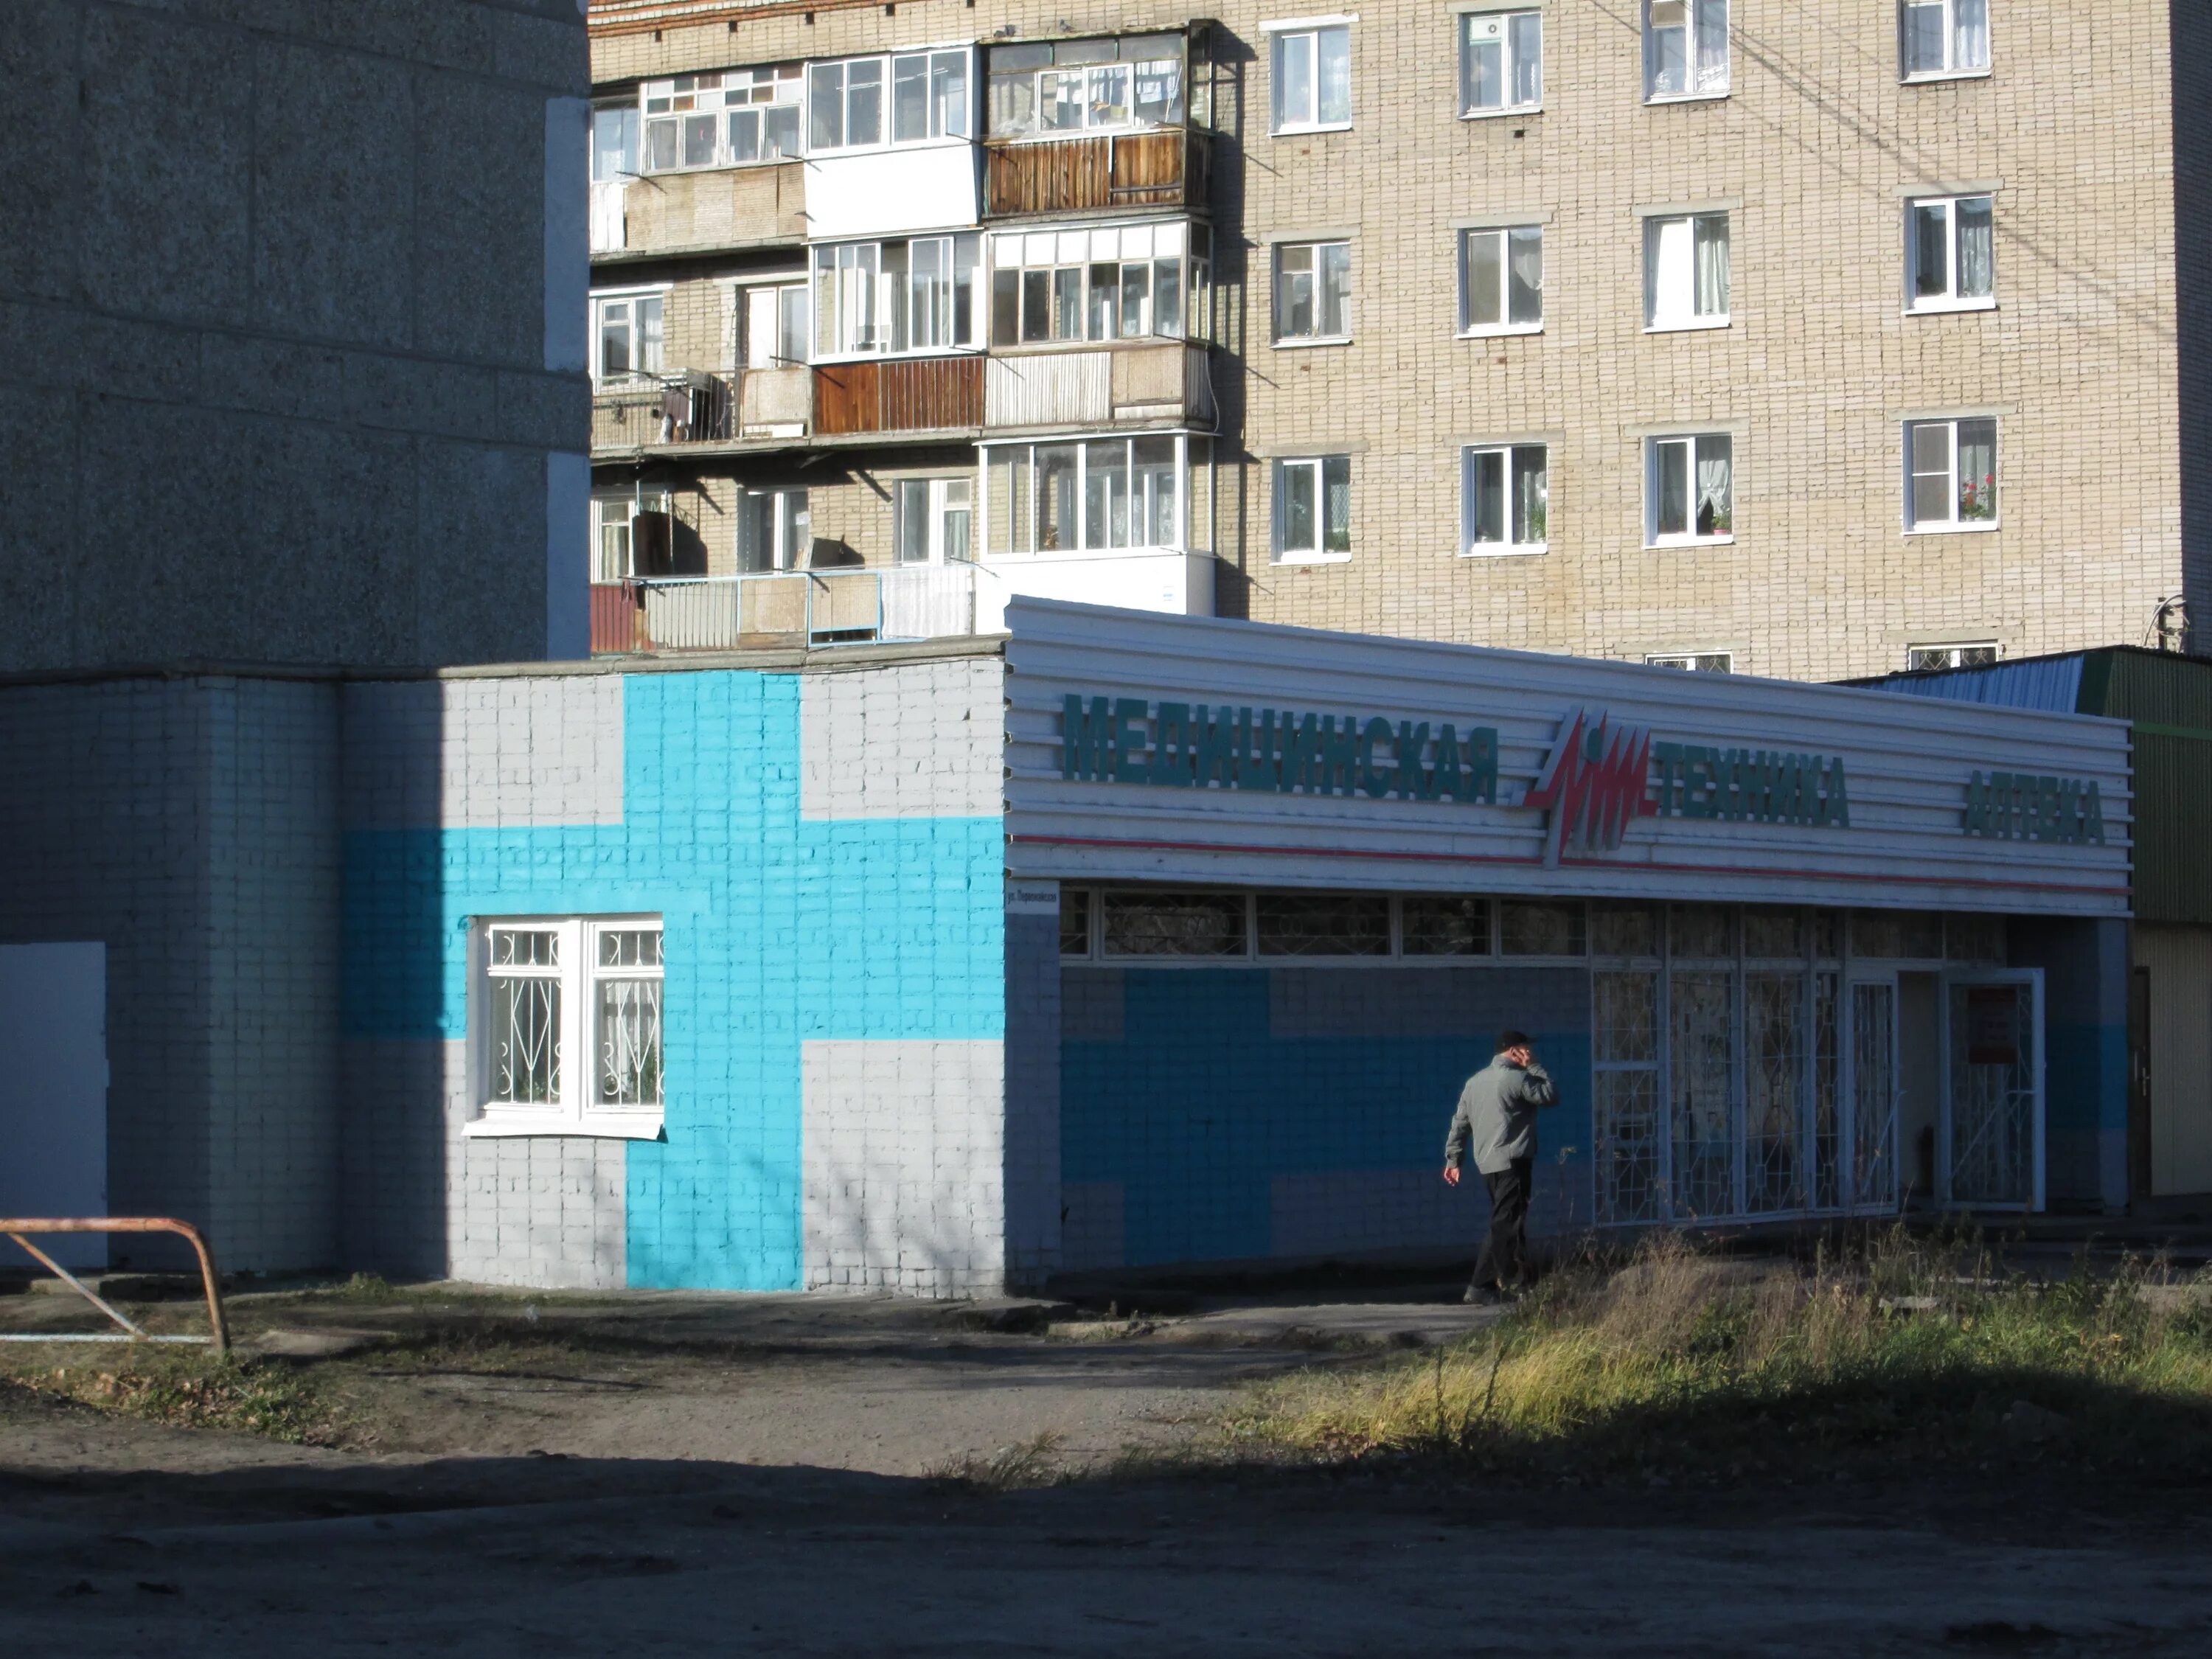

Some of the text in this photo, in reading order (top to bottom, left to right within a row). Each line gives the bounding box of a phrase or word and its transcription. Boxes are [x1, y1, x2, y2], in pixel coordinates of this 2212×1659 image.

[1064, 694, 1849, 828] МЕДИЦИНСКАЯ ТЕХНИКА
[1964, 770, 2105, 845] АПТЕКА
